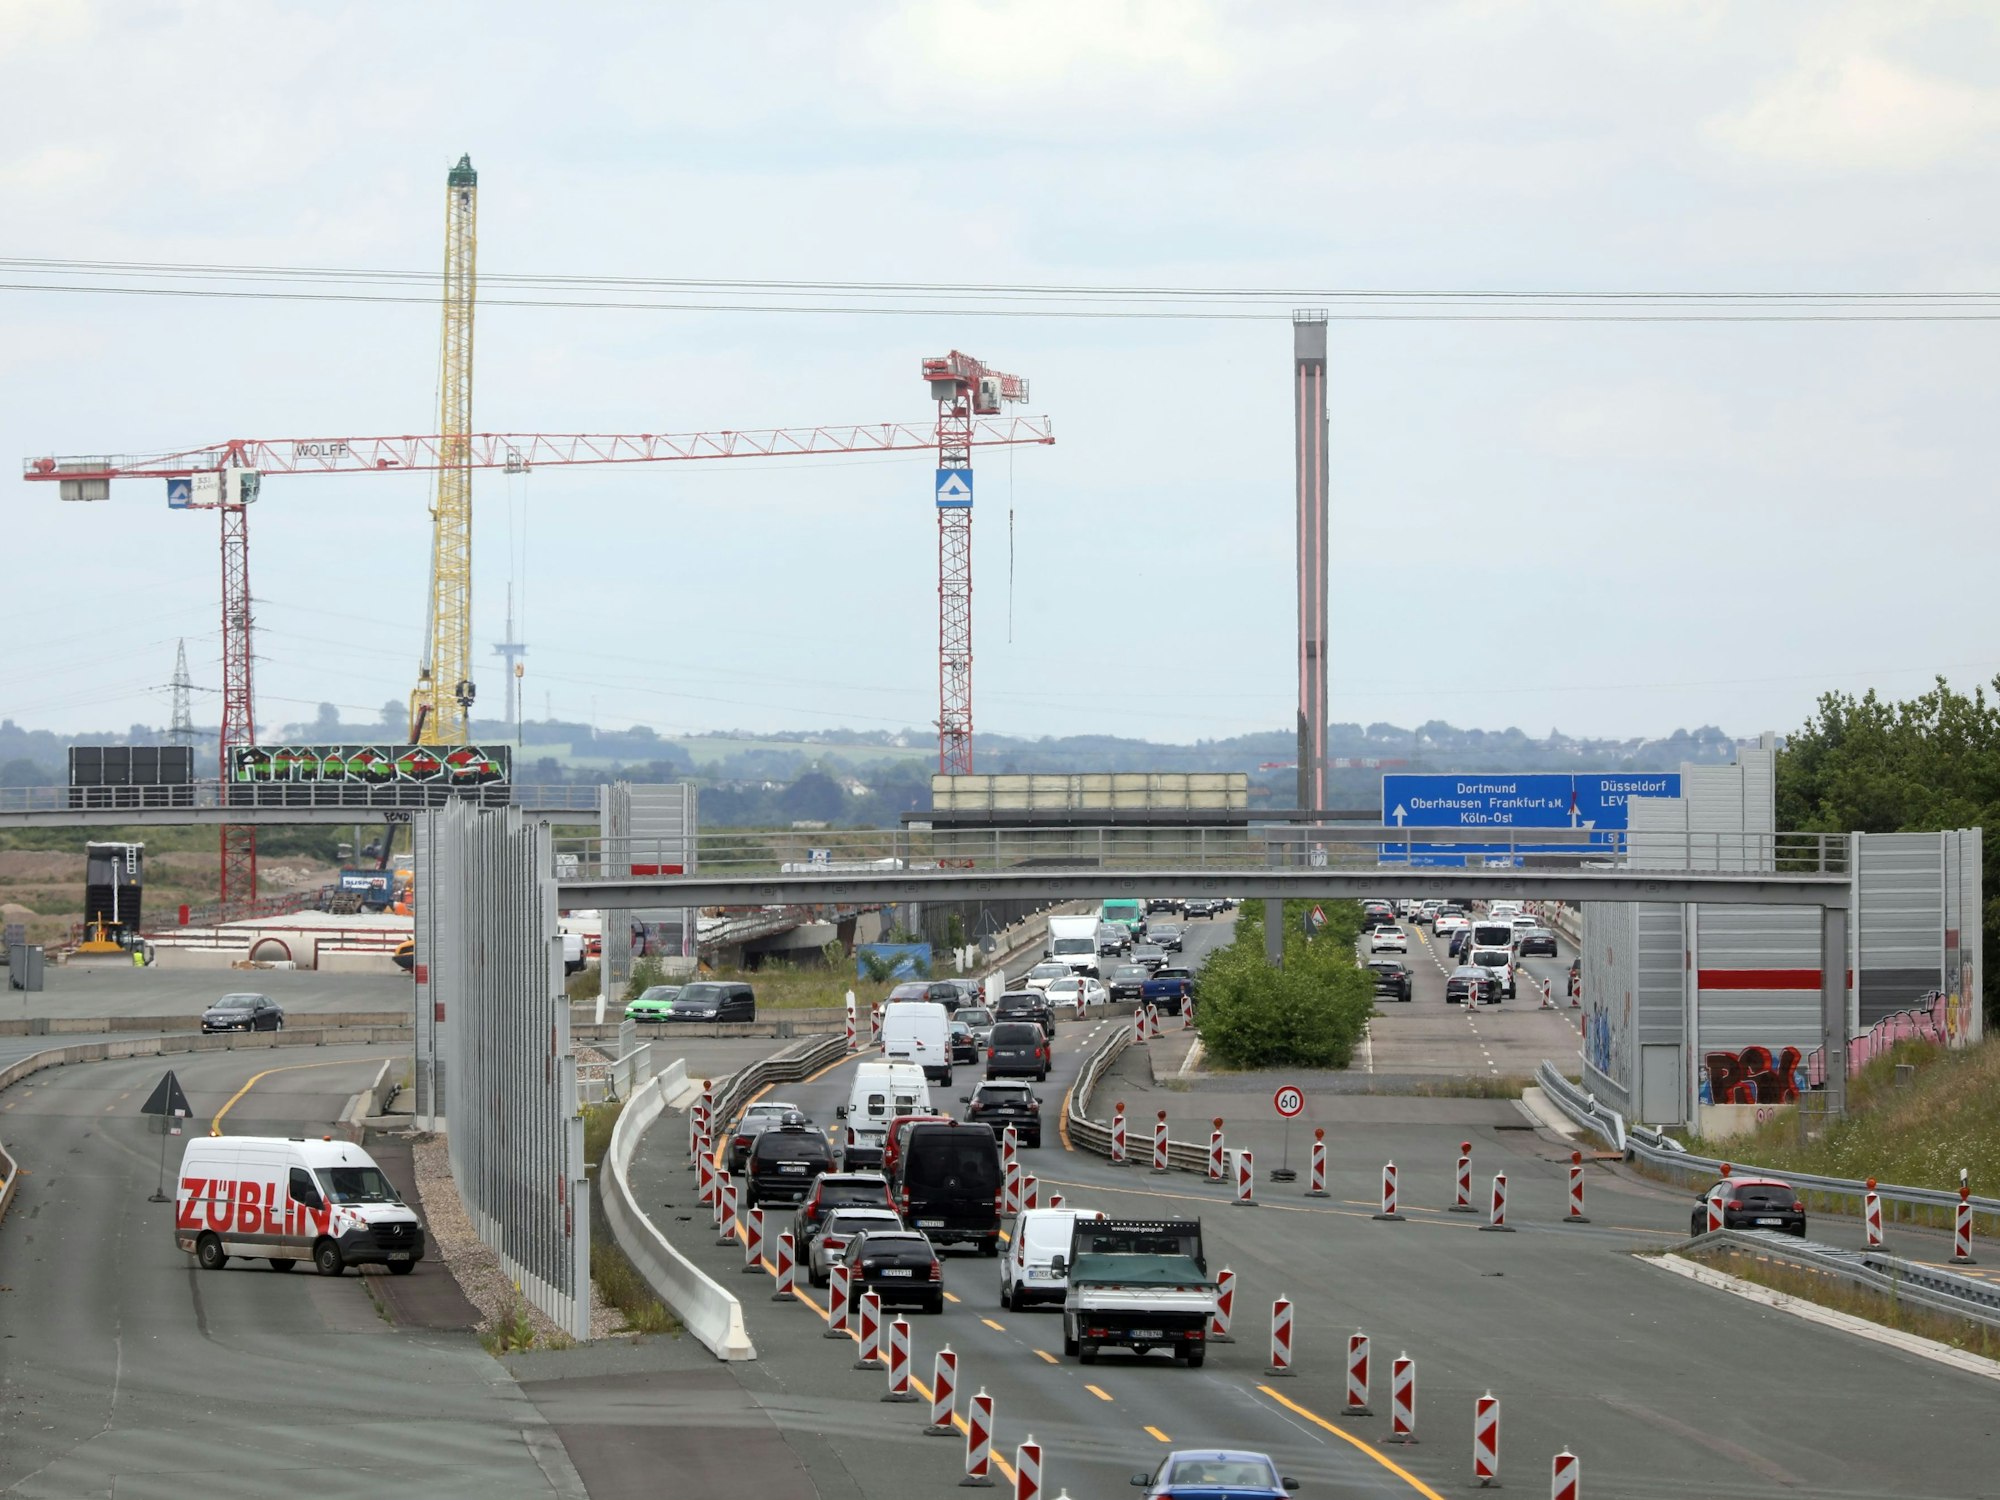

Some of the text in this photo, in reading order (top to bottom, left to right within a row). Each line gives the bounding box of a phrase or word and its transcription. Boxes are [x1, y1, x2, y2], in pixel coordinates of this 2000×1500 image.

[297, 444, 347, 456] WOLFF
[1457, 783, 1516, 794] Dortmund
[1601, 780, 1666, 792] Düsseldorf
[1411, 797, 1481, 809] Oberhausen
[1489, 797, 1545, 808] Frankfurt
[1460, 812, 1513, 823] Köln-Ost
[1280, 1094, 1298, 1109] 60
[177, 1178, 331, 1236] ZÜBLIN
